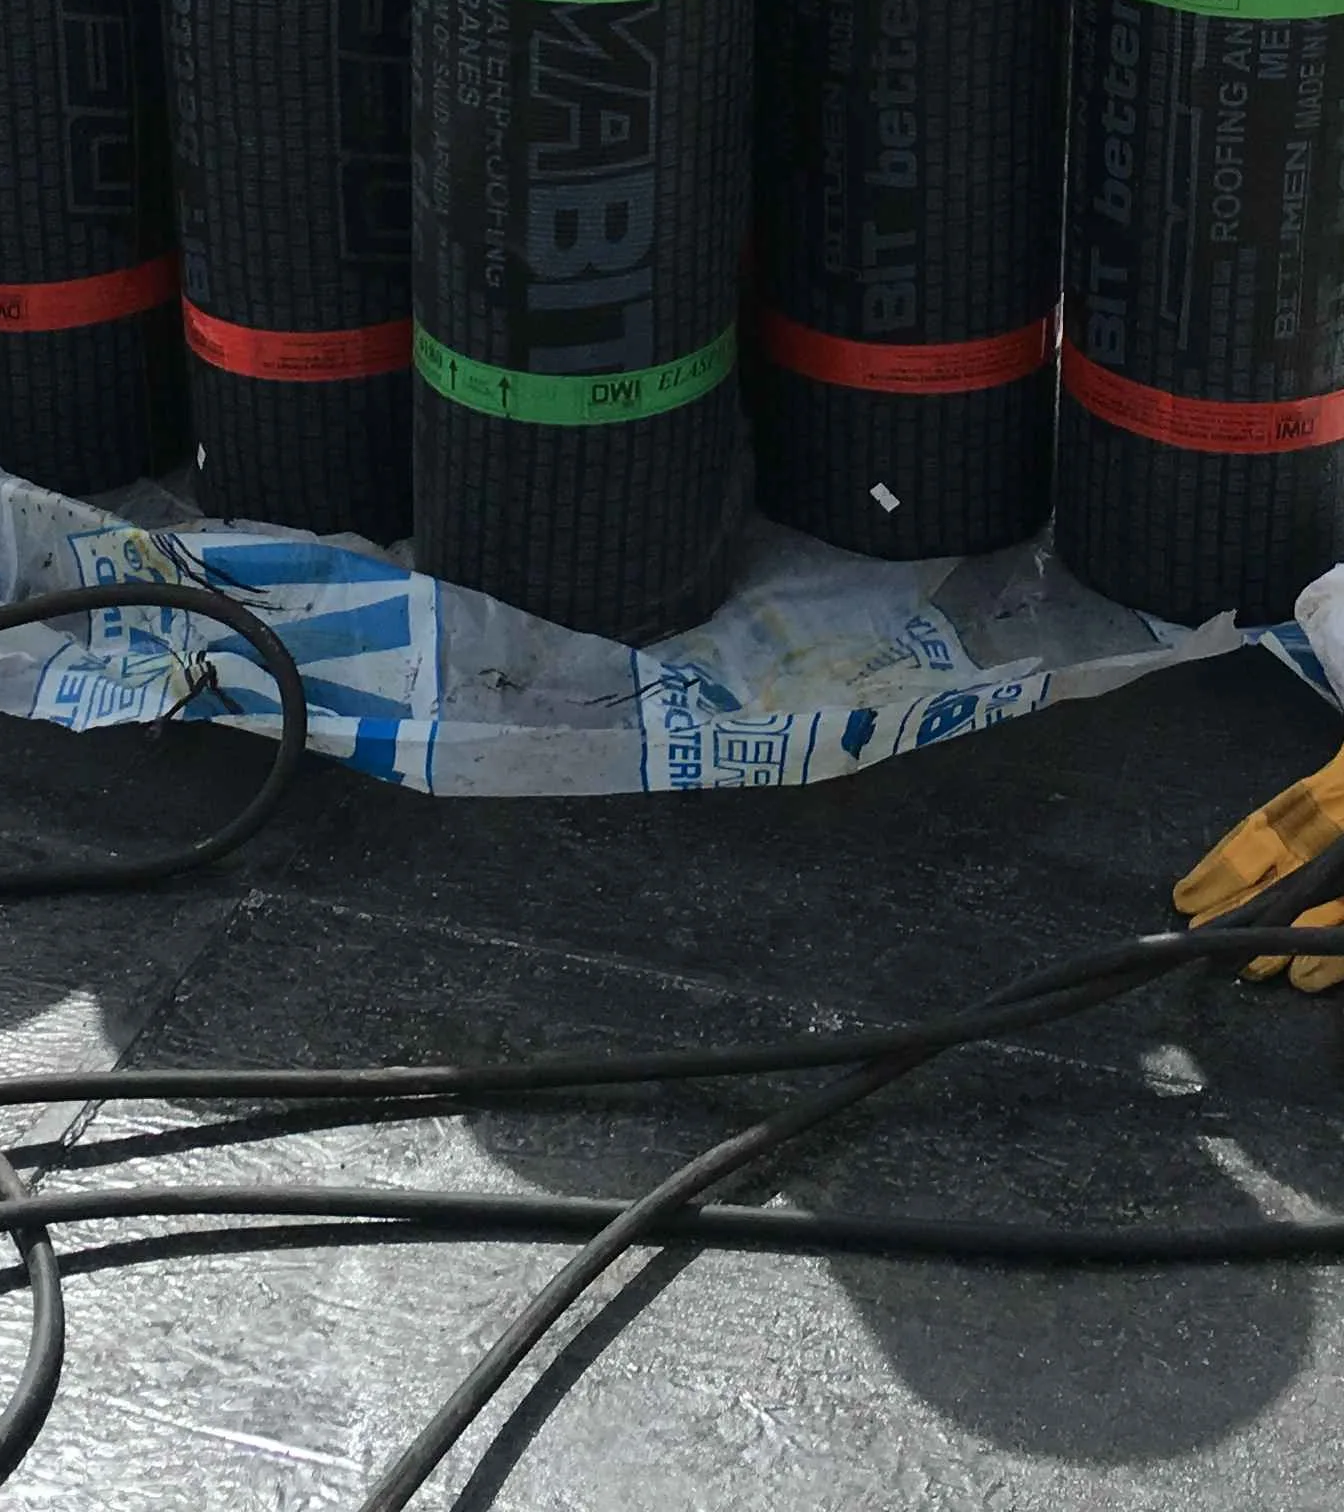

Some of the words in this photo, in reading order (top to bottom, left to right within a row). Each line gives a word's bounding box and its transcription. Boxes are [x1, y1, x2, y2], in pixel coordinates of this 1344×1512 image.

[829, 8, 855, 71] MADE
[1293, 60, 1325, 127] MADE
[1300, 31, 1327, 54] IN
[1209, 81, 1249, 242] ROOFING
[856, 219, 918, 333] BIT
[1272, 139, 1312, 340] BITUMEN
[1086, 243, 1129, 364] BIT
